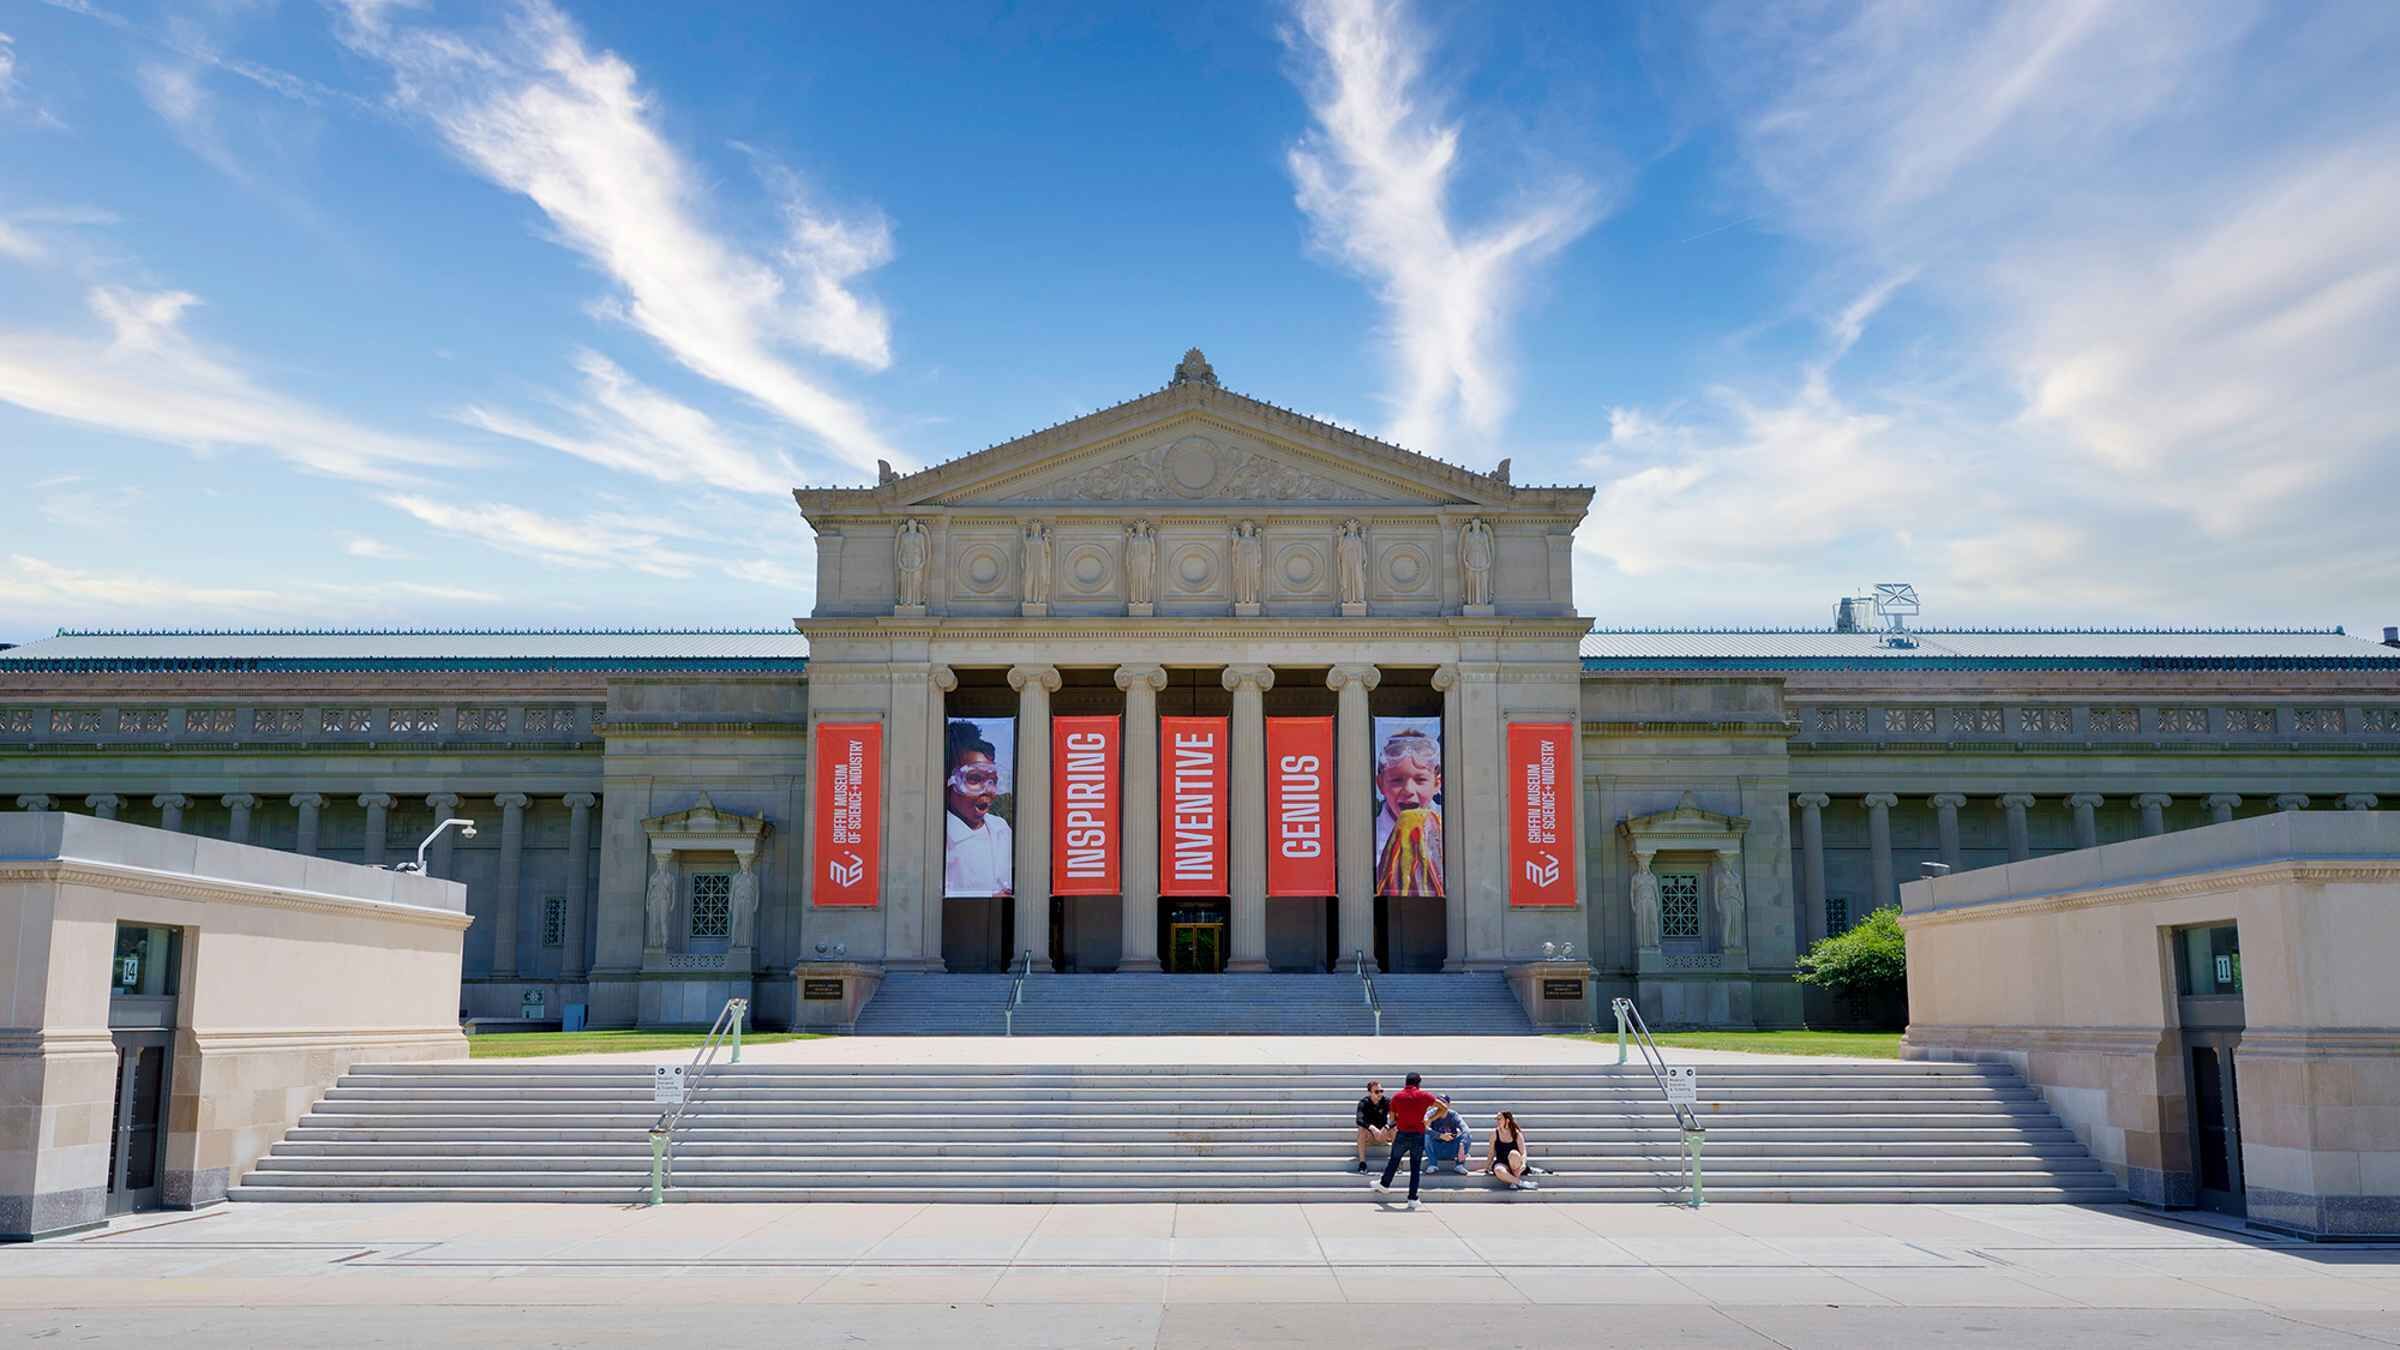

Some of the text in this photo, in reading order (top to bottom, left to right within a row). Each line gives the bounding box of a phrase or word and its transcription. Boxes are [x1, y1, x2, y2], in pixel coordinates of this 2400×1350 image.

[833, 764, 848, 844] GRIFFIN MUSEUM
[847, 831, 862, 844] OF
[1067, 733, 1105, 878] INSPIRING
[1175, 732, 1214, 880] INVENTIVE
[1281, 755, 1321, 858] GENIUS
[1527, 763, 1541, 844] GRIFFIN MUSEUM
[1541, 831, 1556, 844] OF
[125, 961, 136, 981] 14
[2219, 959, 2229, 979] 11
